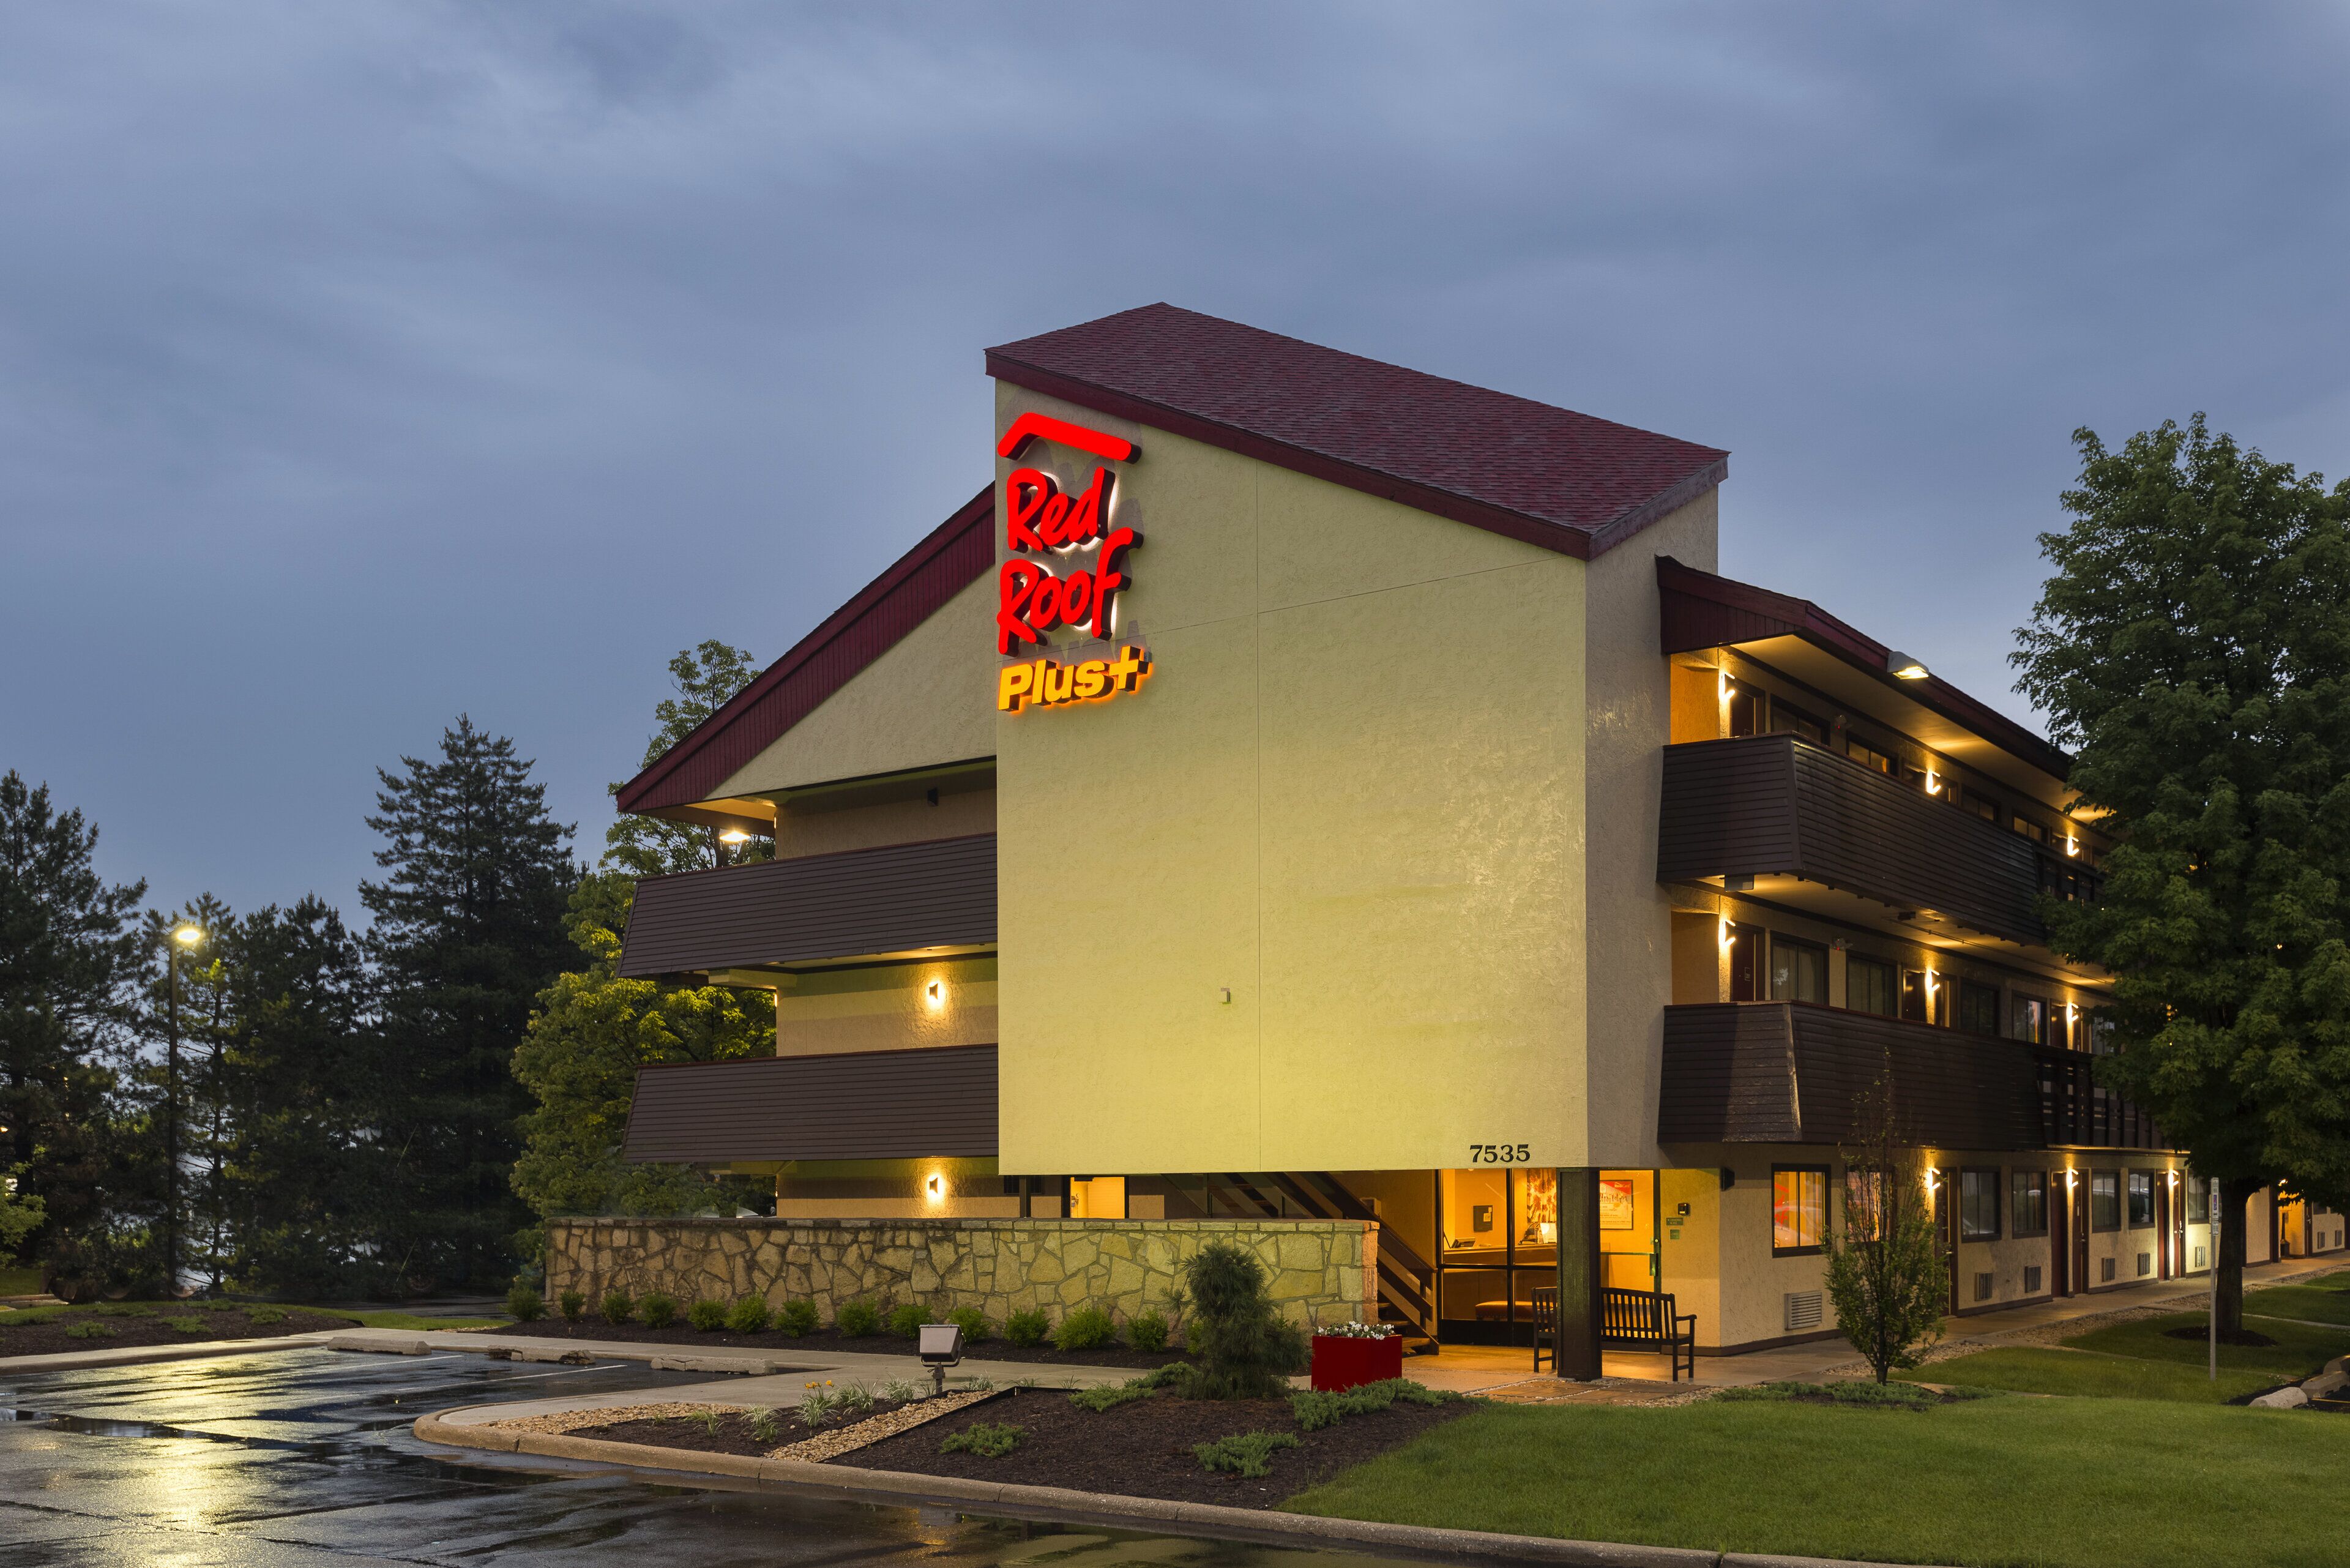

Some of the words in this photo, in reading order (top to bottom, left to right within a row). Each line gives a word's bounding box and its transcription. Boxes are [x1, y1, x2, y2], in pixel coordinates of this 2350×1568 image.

[1006, 466, 1105, 551] Red
[996, 527, 1133, 655] Roof
[998, 646, 1140, 711] Plus+
[1470, 1144, 1531, 1163] 7535
